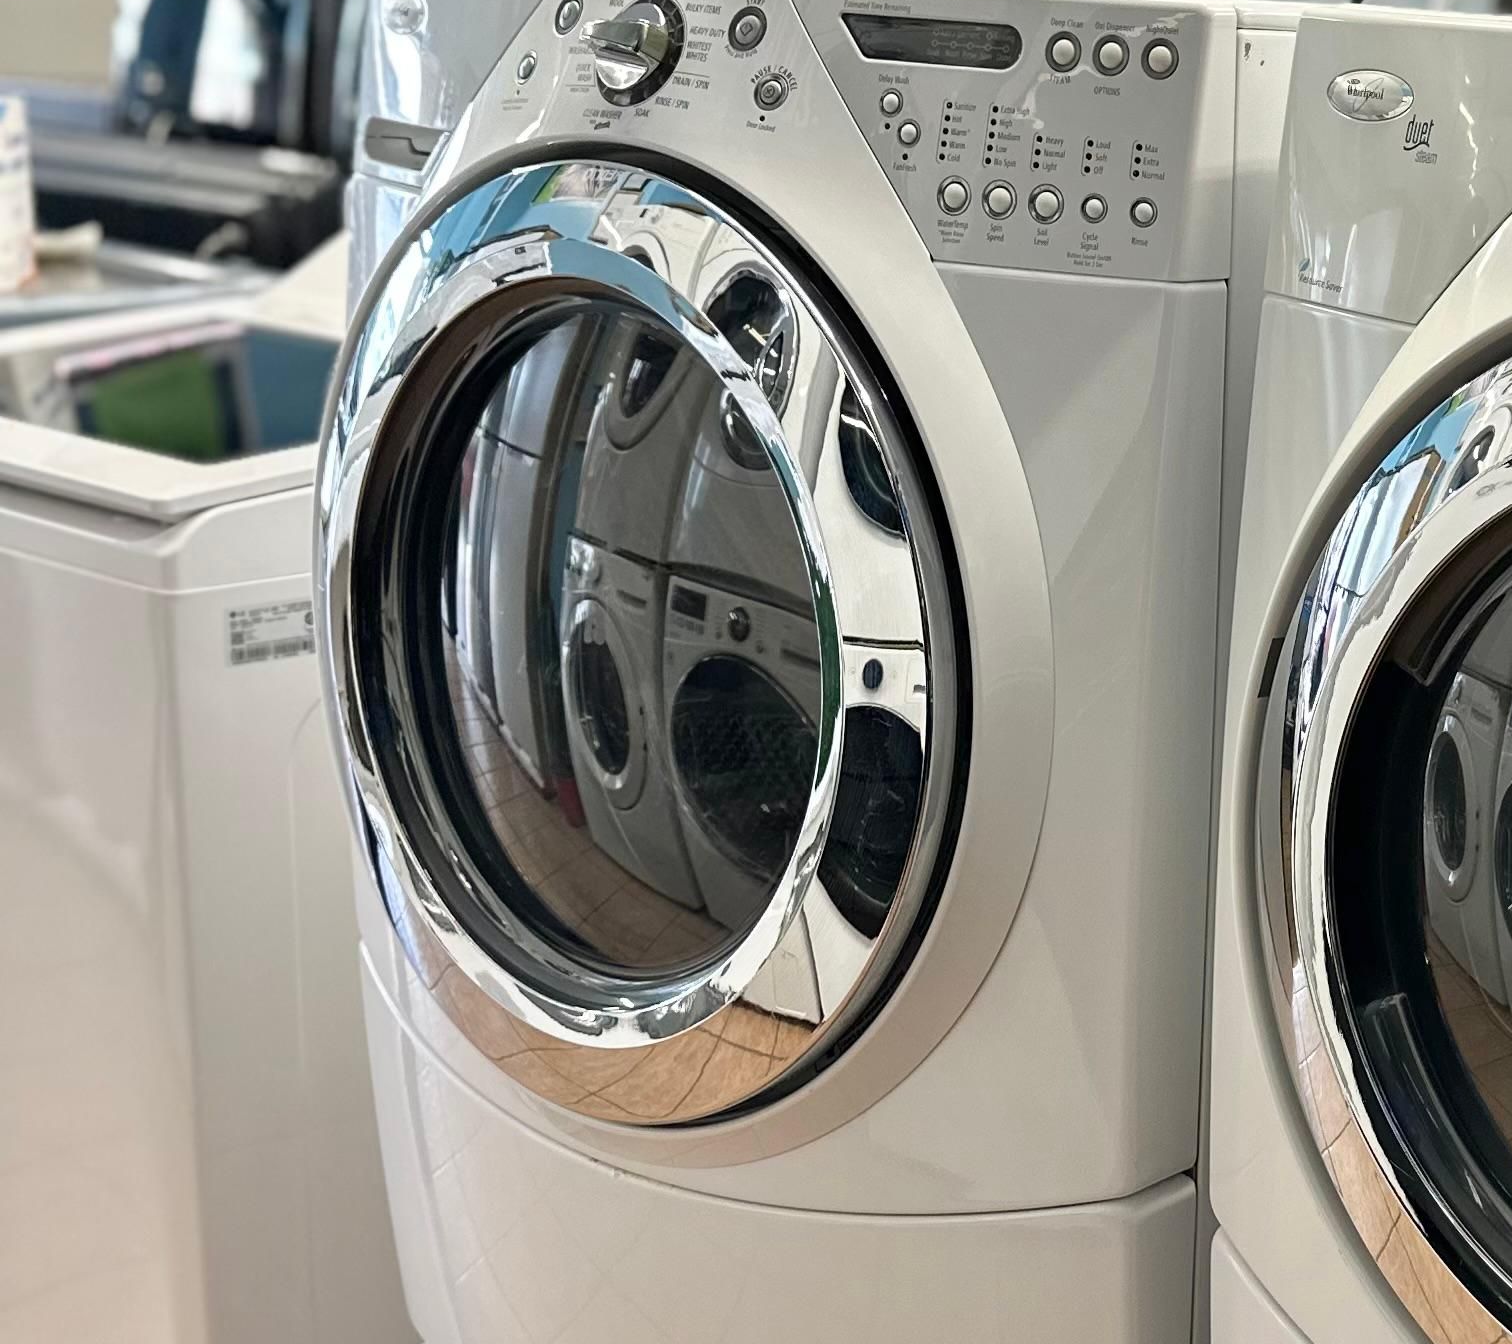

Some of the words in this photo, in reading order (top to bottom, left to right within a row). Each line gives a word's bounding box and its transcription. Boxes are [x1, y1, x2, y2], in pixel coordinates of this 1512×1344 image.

[1050, 17, 1066, 28] Deep
[1066, 18, 1084, 28] Clean
[750, 65, 772, 84] PAUSE
[777, 65, 798, 92] CANCEL
[1093, 85, 1121, 96] OPTIONS
[1403, 114, 1434, 148] duet
[1144, 144, 1159, 153] Max
[1141, 171, 1165, 181] Normal
[1082, 232, 1099, 242] Cycle
